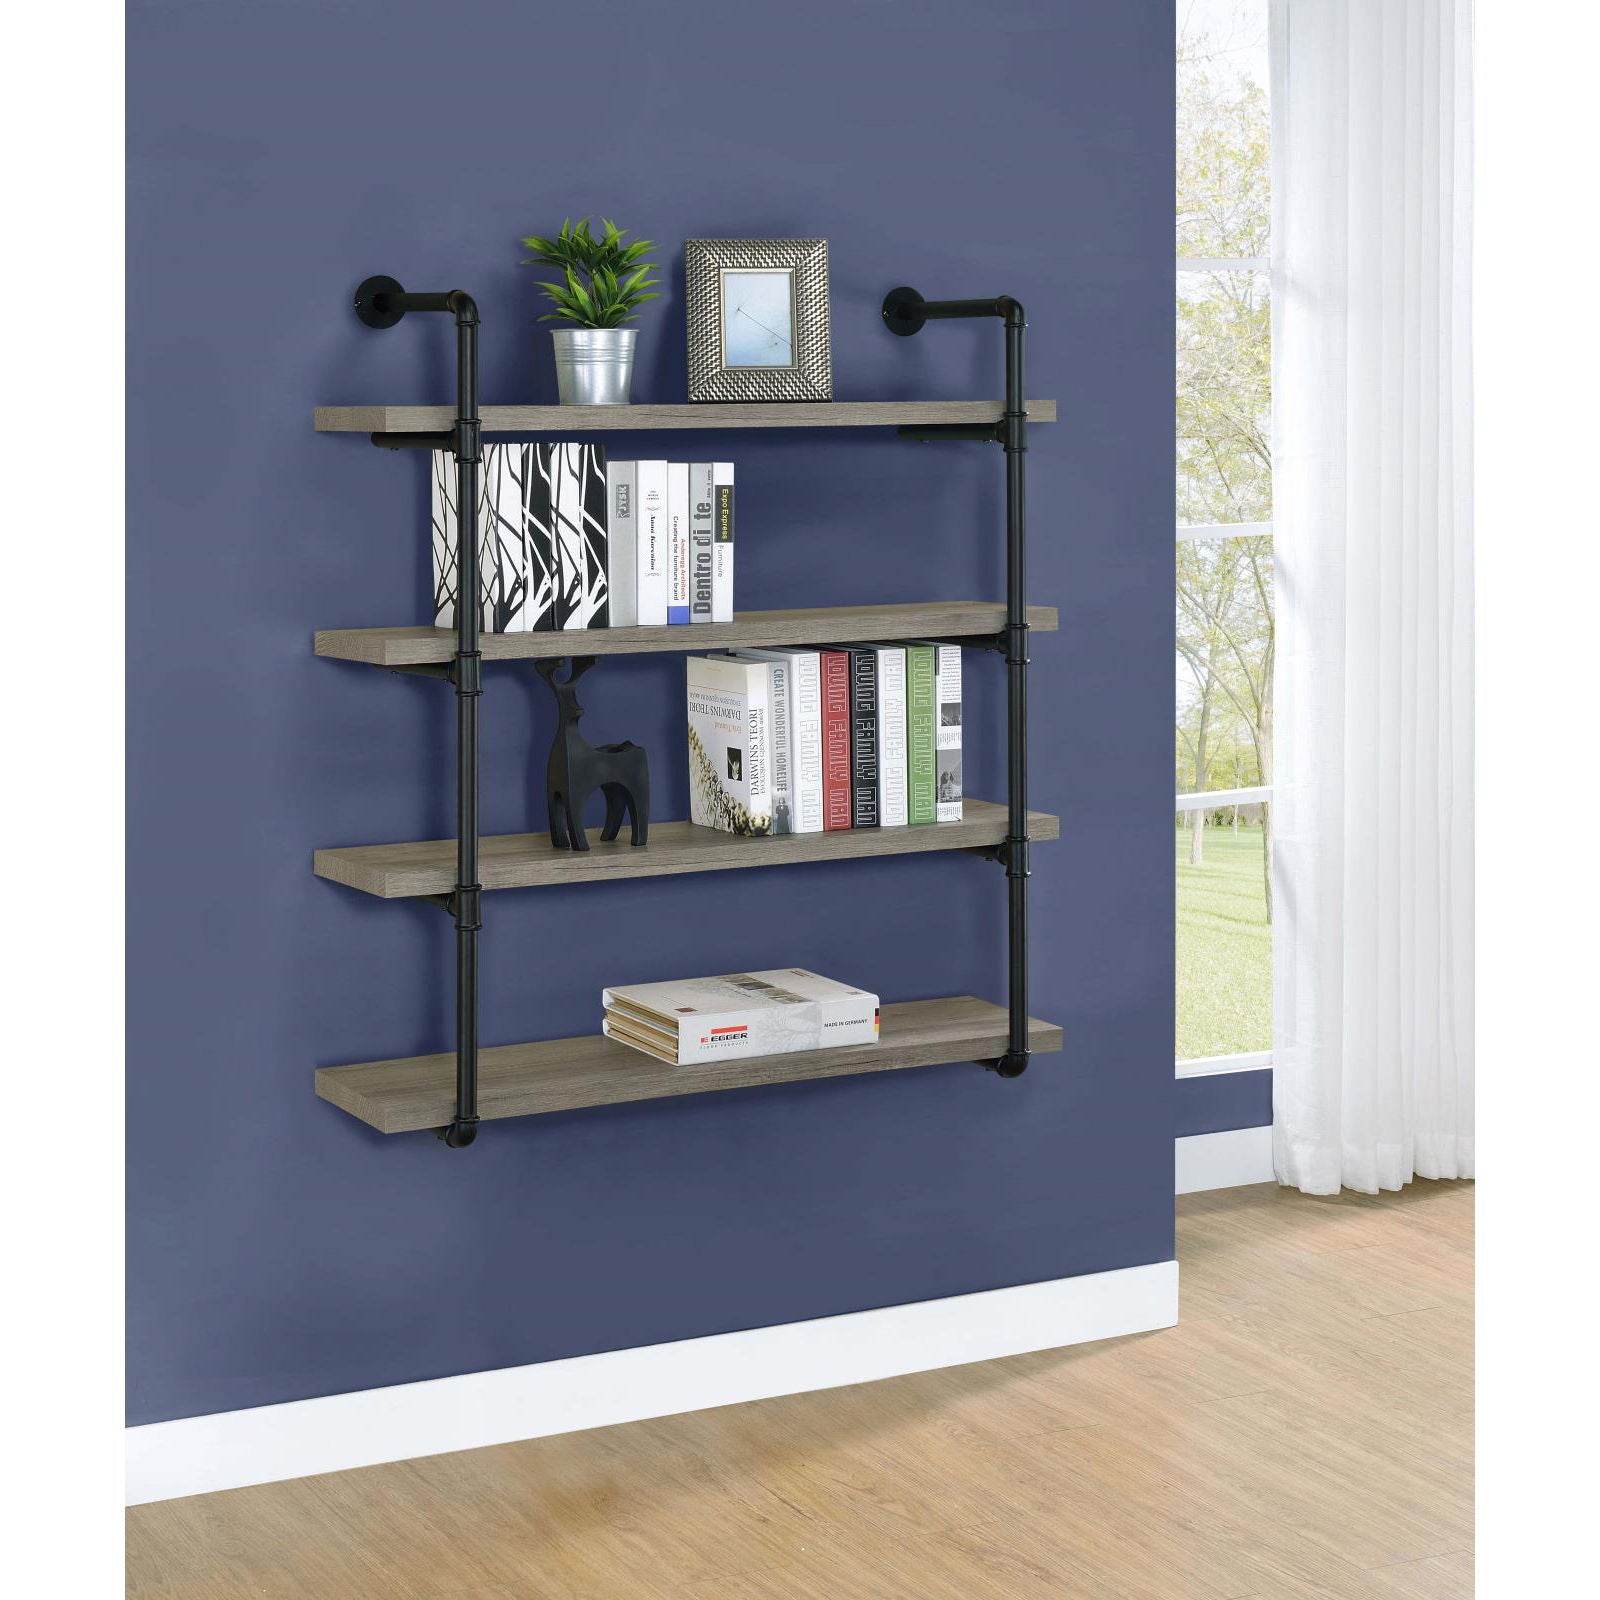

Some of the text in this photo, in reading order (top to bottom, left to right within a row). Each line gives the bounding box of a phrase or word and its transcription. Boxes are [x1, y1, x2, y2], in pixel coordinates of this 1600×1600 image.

[618, 486, 627, 511] JYSK
[721, 488, 729, 540] Expo Express
[693, 502, 711, 614] Dentro di te
[689, 702, 742, 720] DARWINS TEORI
[749, 709, 759, 796] DARWINS TEORI
[774, 668, 787, 792] CREATE WONDERFUL HOMELIFE
[800, 654, 820, 828] LOVING FAMILY MAN
[828, 655, 849, 827] LOVING FAMILY MAN
[856, 655, 876, 825] LOVING FAMILY MAN
[885, 654, 904, 823] LOVING FAMILY MAN
[913, 651, 933, 820] LOVING FAMILY MAN
[711, 1032, 748, 1042] EGGER
